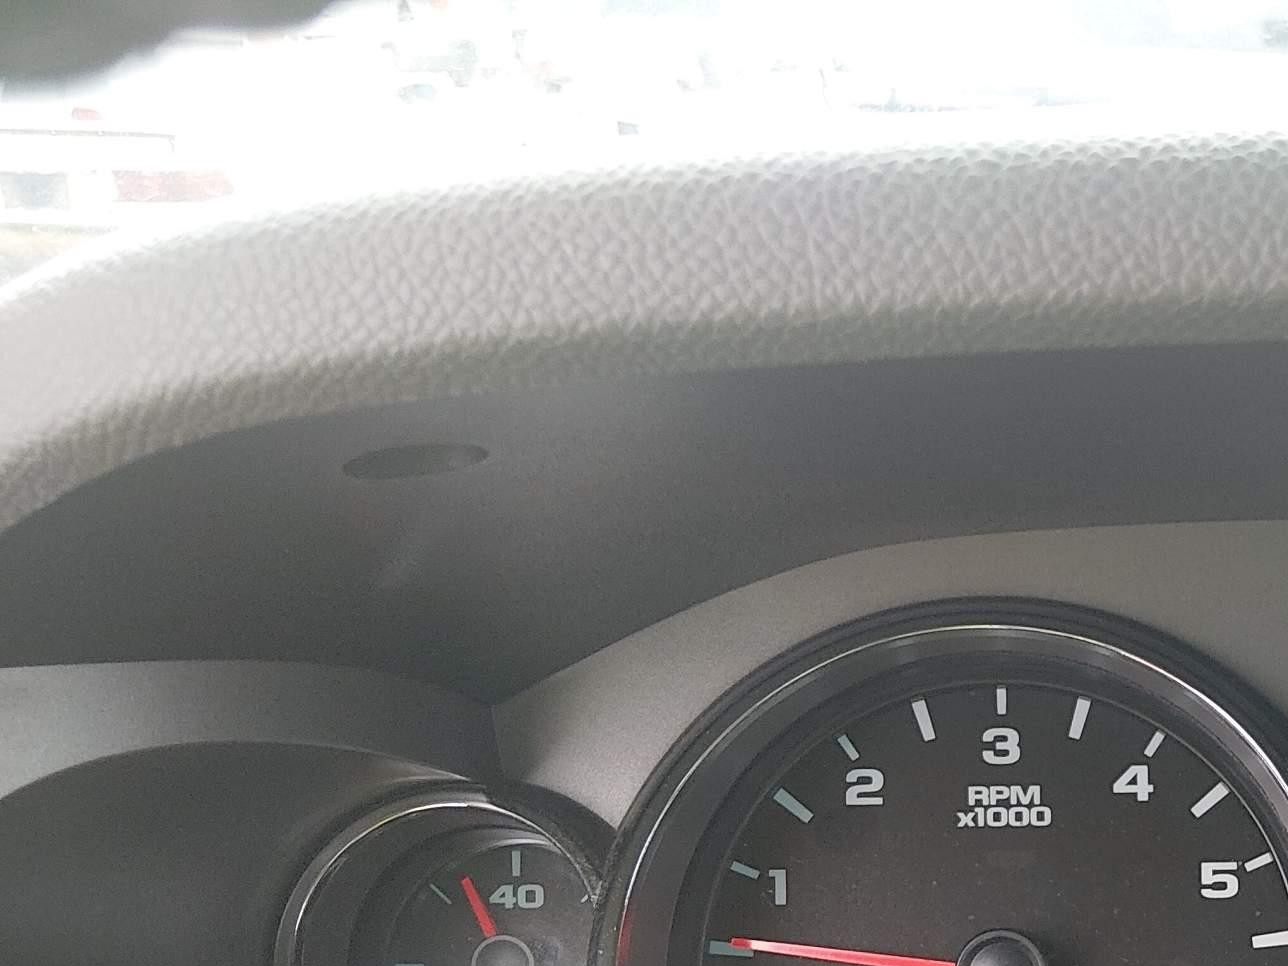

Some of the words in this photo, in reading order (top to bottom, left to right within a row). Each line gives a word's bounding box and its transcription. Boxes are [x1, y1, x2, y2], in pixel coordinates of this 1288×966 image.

[982, 728, 1020, 766] 3
[846, 769, 885, 806] 2
[968, 786, 1040, 805] RPM
[1112, 766, 1154, 801] 4
[957, 806, 1052, 828] x1000
[488, 884, 544, 909] 40
[768, 870, 786, 906] 1
[1200, 862, 1240, 899] 5
